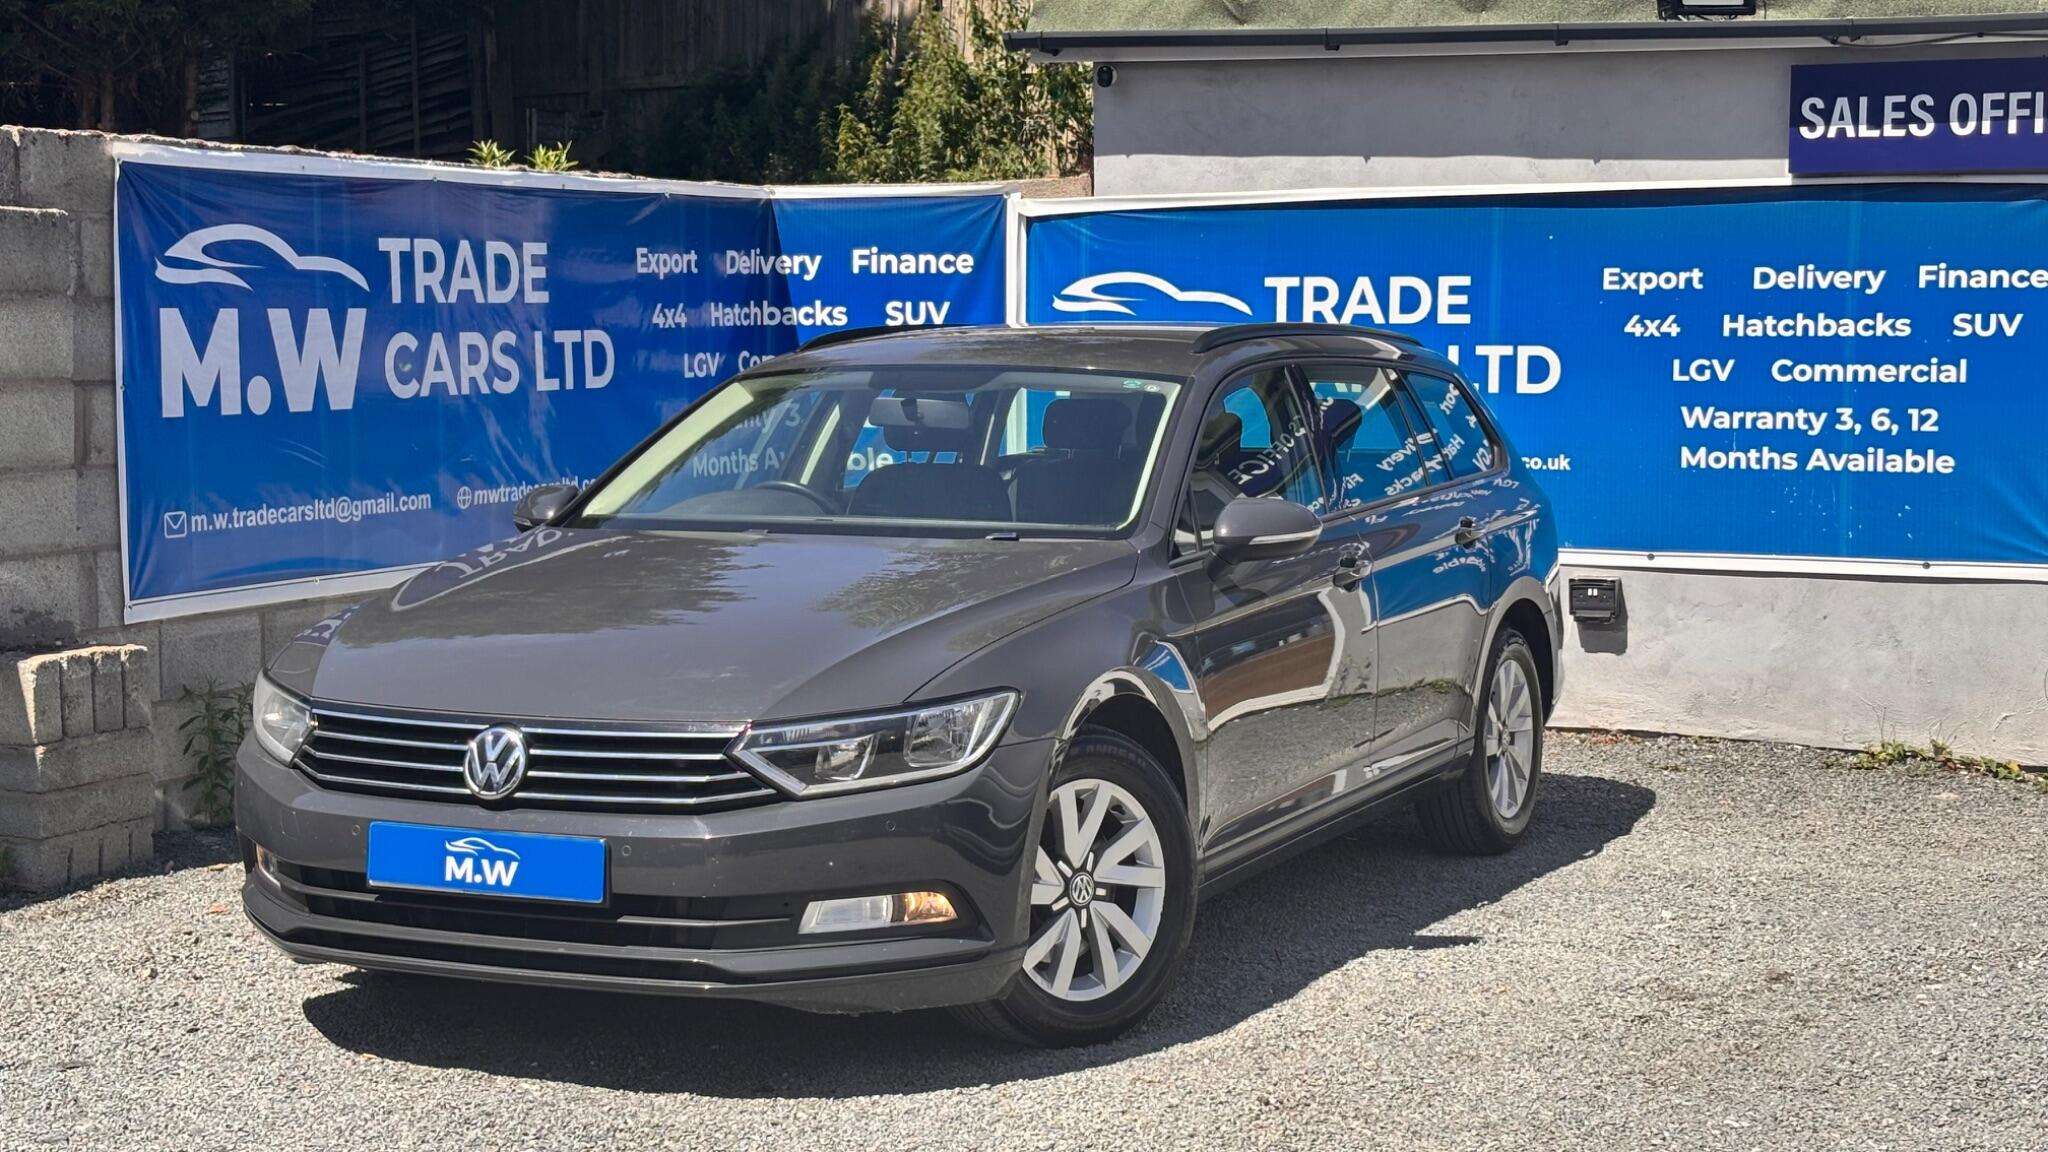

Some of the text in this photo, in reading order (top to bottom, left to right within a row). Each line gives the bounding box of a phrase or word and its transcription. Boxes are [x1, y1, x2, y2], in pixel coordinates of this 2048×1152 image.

[1799, 94, 1935, 139] SALES
[378, 237, 550, 304] TRADE
[636, 246, 974, 282] Export Delivery Finance
[1602, 262, 2048, 295] Export Delivery Finance
[652, 300, 951, 329] 4x4 Hatchbacks SUV
[1264, 275, 1472, 324] TRADE
[1624, 312, 2024, 337] 4x4 Hatchbacks SUV
[159, 307, 367, 418] M.W
[384, 329, 615, 399] CARS LTD
[683, 352, 721, 378] LGV
[1672, 357, 1967, 383] LGV Commercial
[1680, 406, 1939, 436] Warranty 3, 6, 12
[1680, 446, 1956, 474] Months Available
[191, 492, 432, 533] m.w.tradecarsltd@gmail.com
[444, 855, 519, 887] M.W
